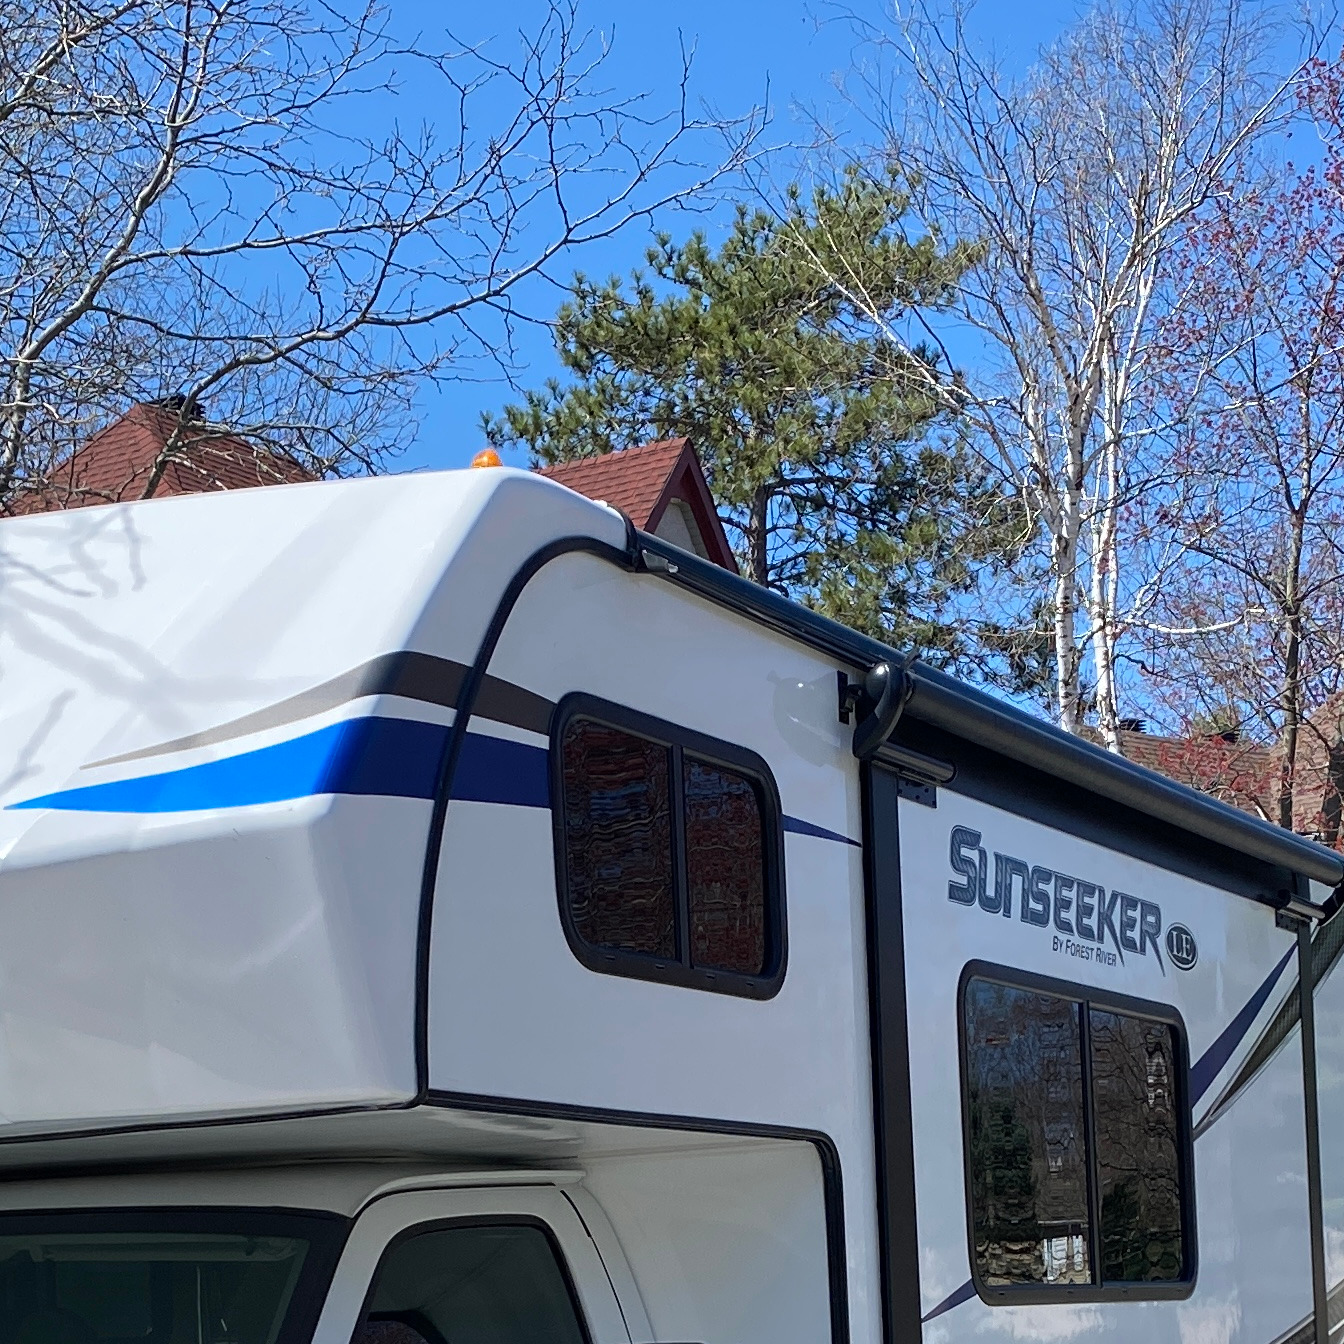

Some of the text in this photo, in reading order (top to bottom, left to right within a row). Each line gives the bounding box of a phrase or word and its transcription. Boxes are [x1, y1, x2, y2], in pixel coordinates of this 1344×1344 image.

[1065, 939, 1095, 961] FOREST
[1095, 947, 1117, 967] RIVER
[1171, 930, 1194, 961] LE
